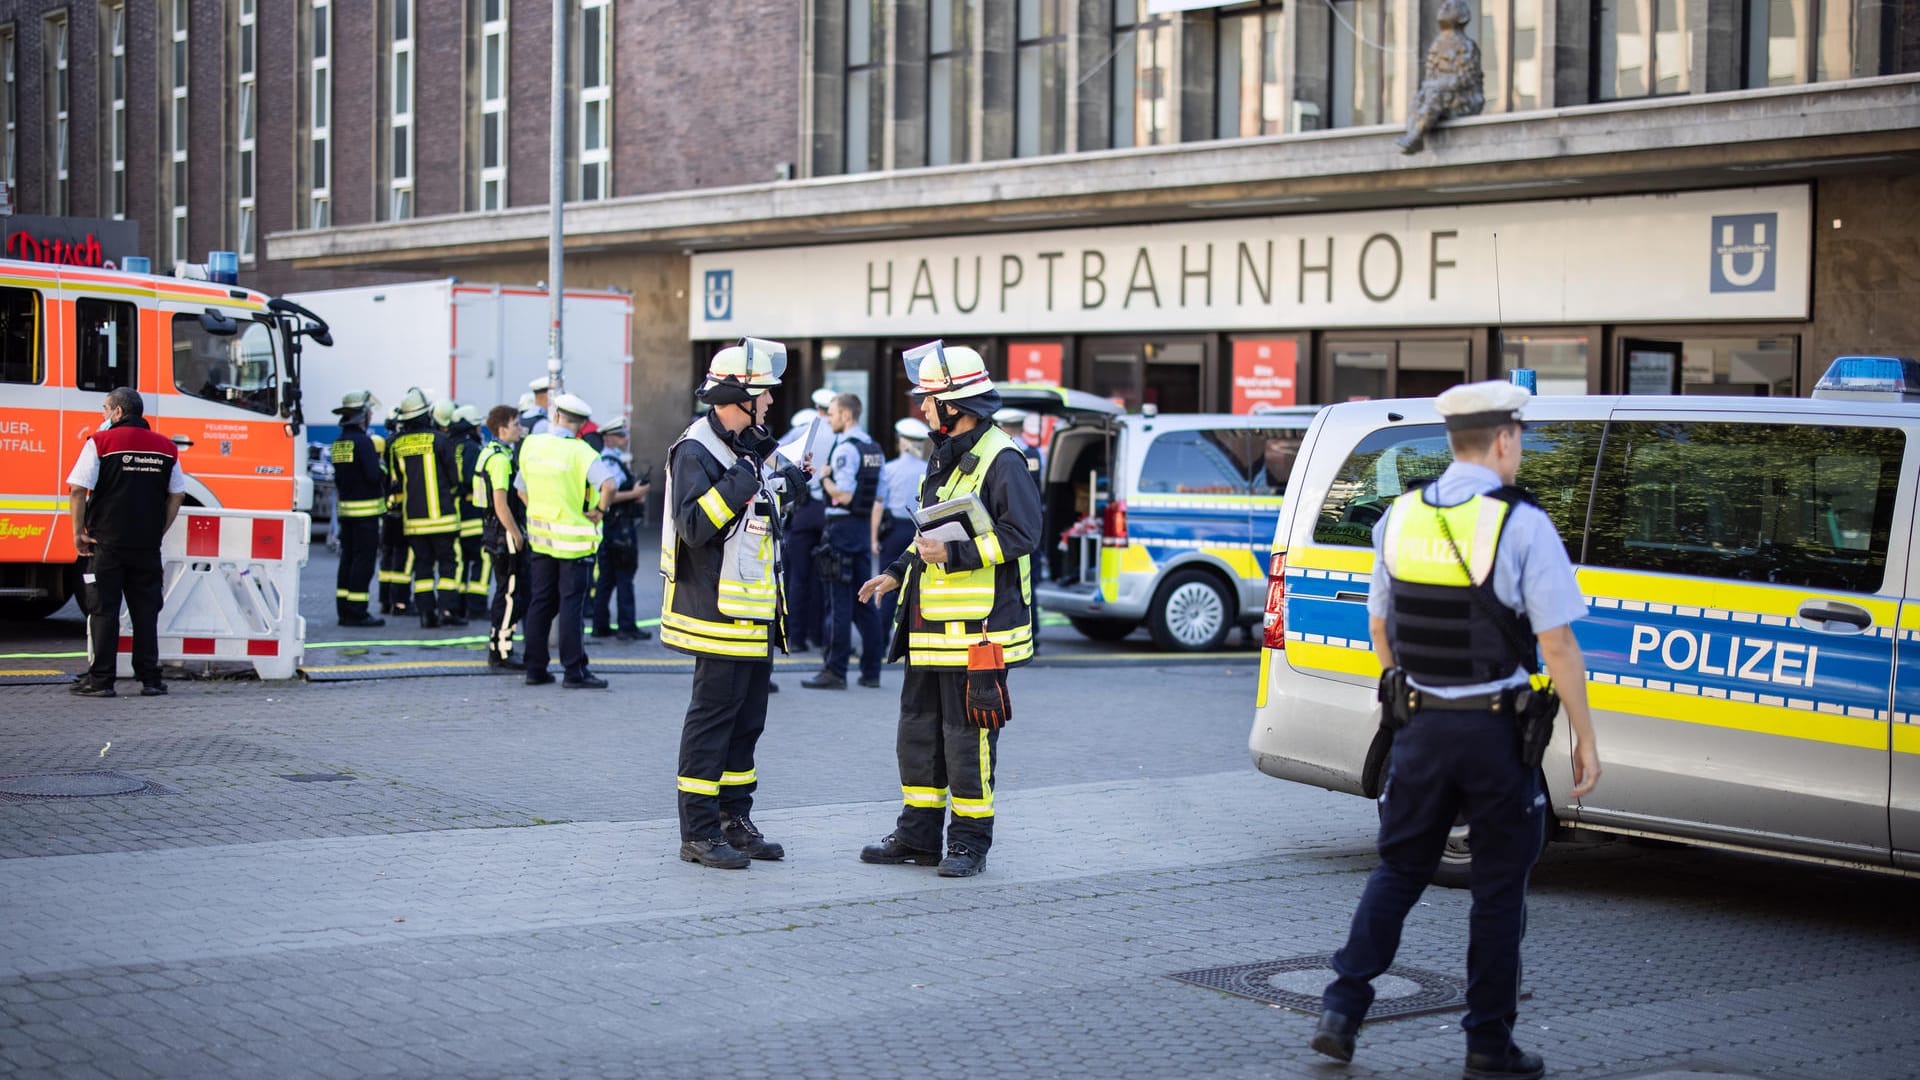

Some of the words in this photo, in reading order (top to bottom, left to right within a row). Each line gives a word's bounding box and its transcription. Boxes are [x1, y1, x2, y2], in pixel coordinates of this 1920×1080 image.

[7, 230, 101, 267] Ditsch
[867, 230, 1458, 316] HAUPTBAHNHOF
[1722, 223, 1765, 286] U
[708, 276, 729, 318] U
[0, 438, 46, 453] TFALL
[1629, 624, 1818, 688] POLIZEI
